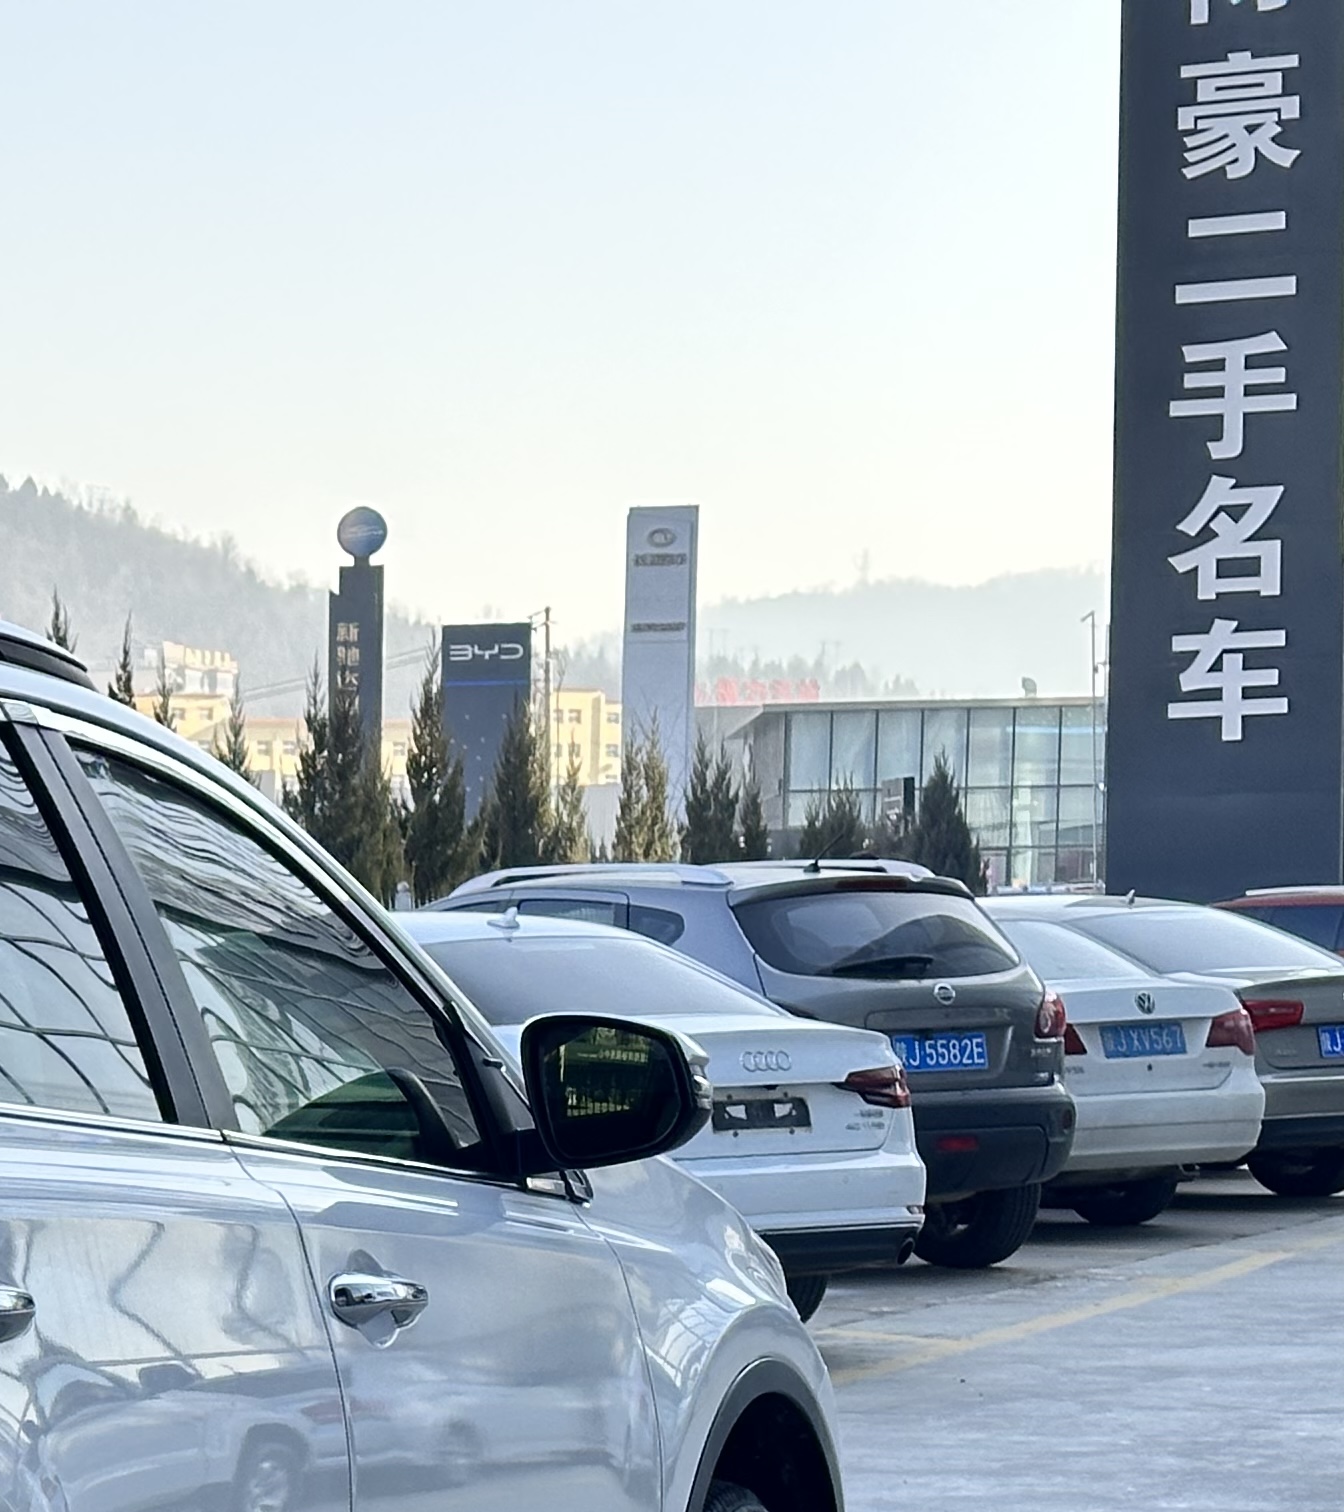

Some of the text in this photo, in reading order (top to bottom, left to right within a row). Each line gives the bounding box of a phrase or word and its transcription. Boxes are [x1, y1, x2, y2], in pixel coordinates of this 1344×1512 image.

[1167, 0, 1302, 742] 豪二手名车
[449, 643, 525, 661] BYD
